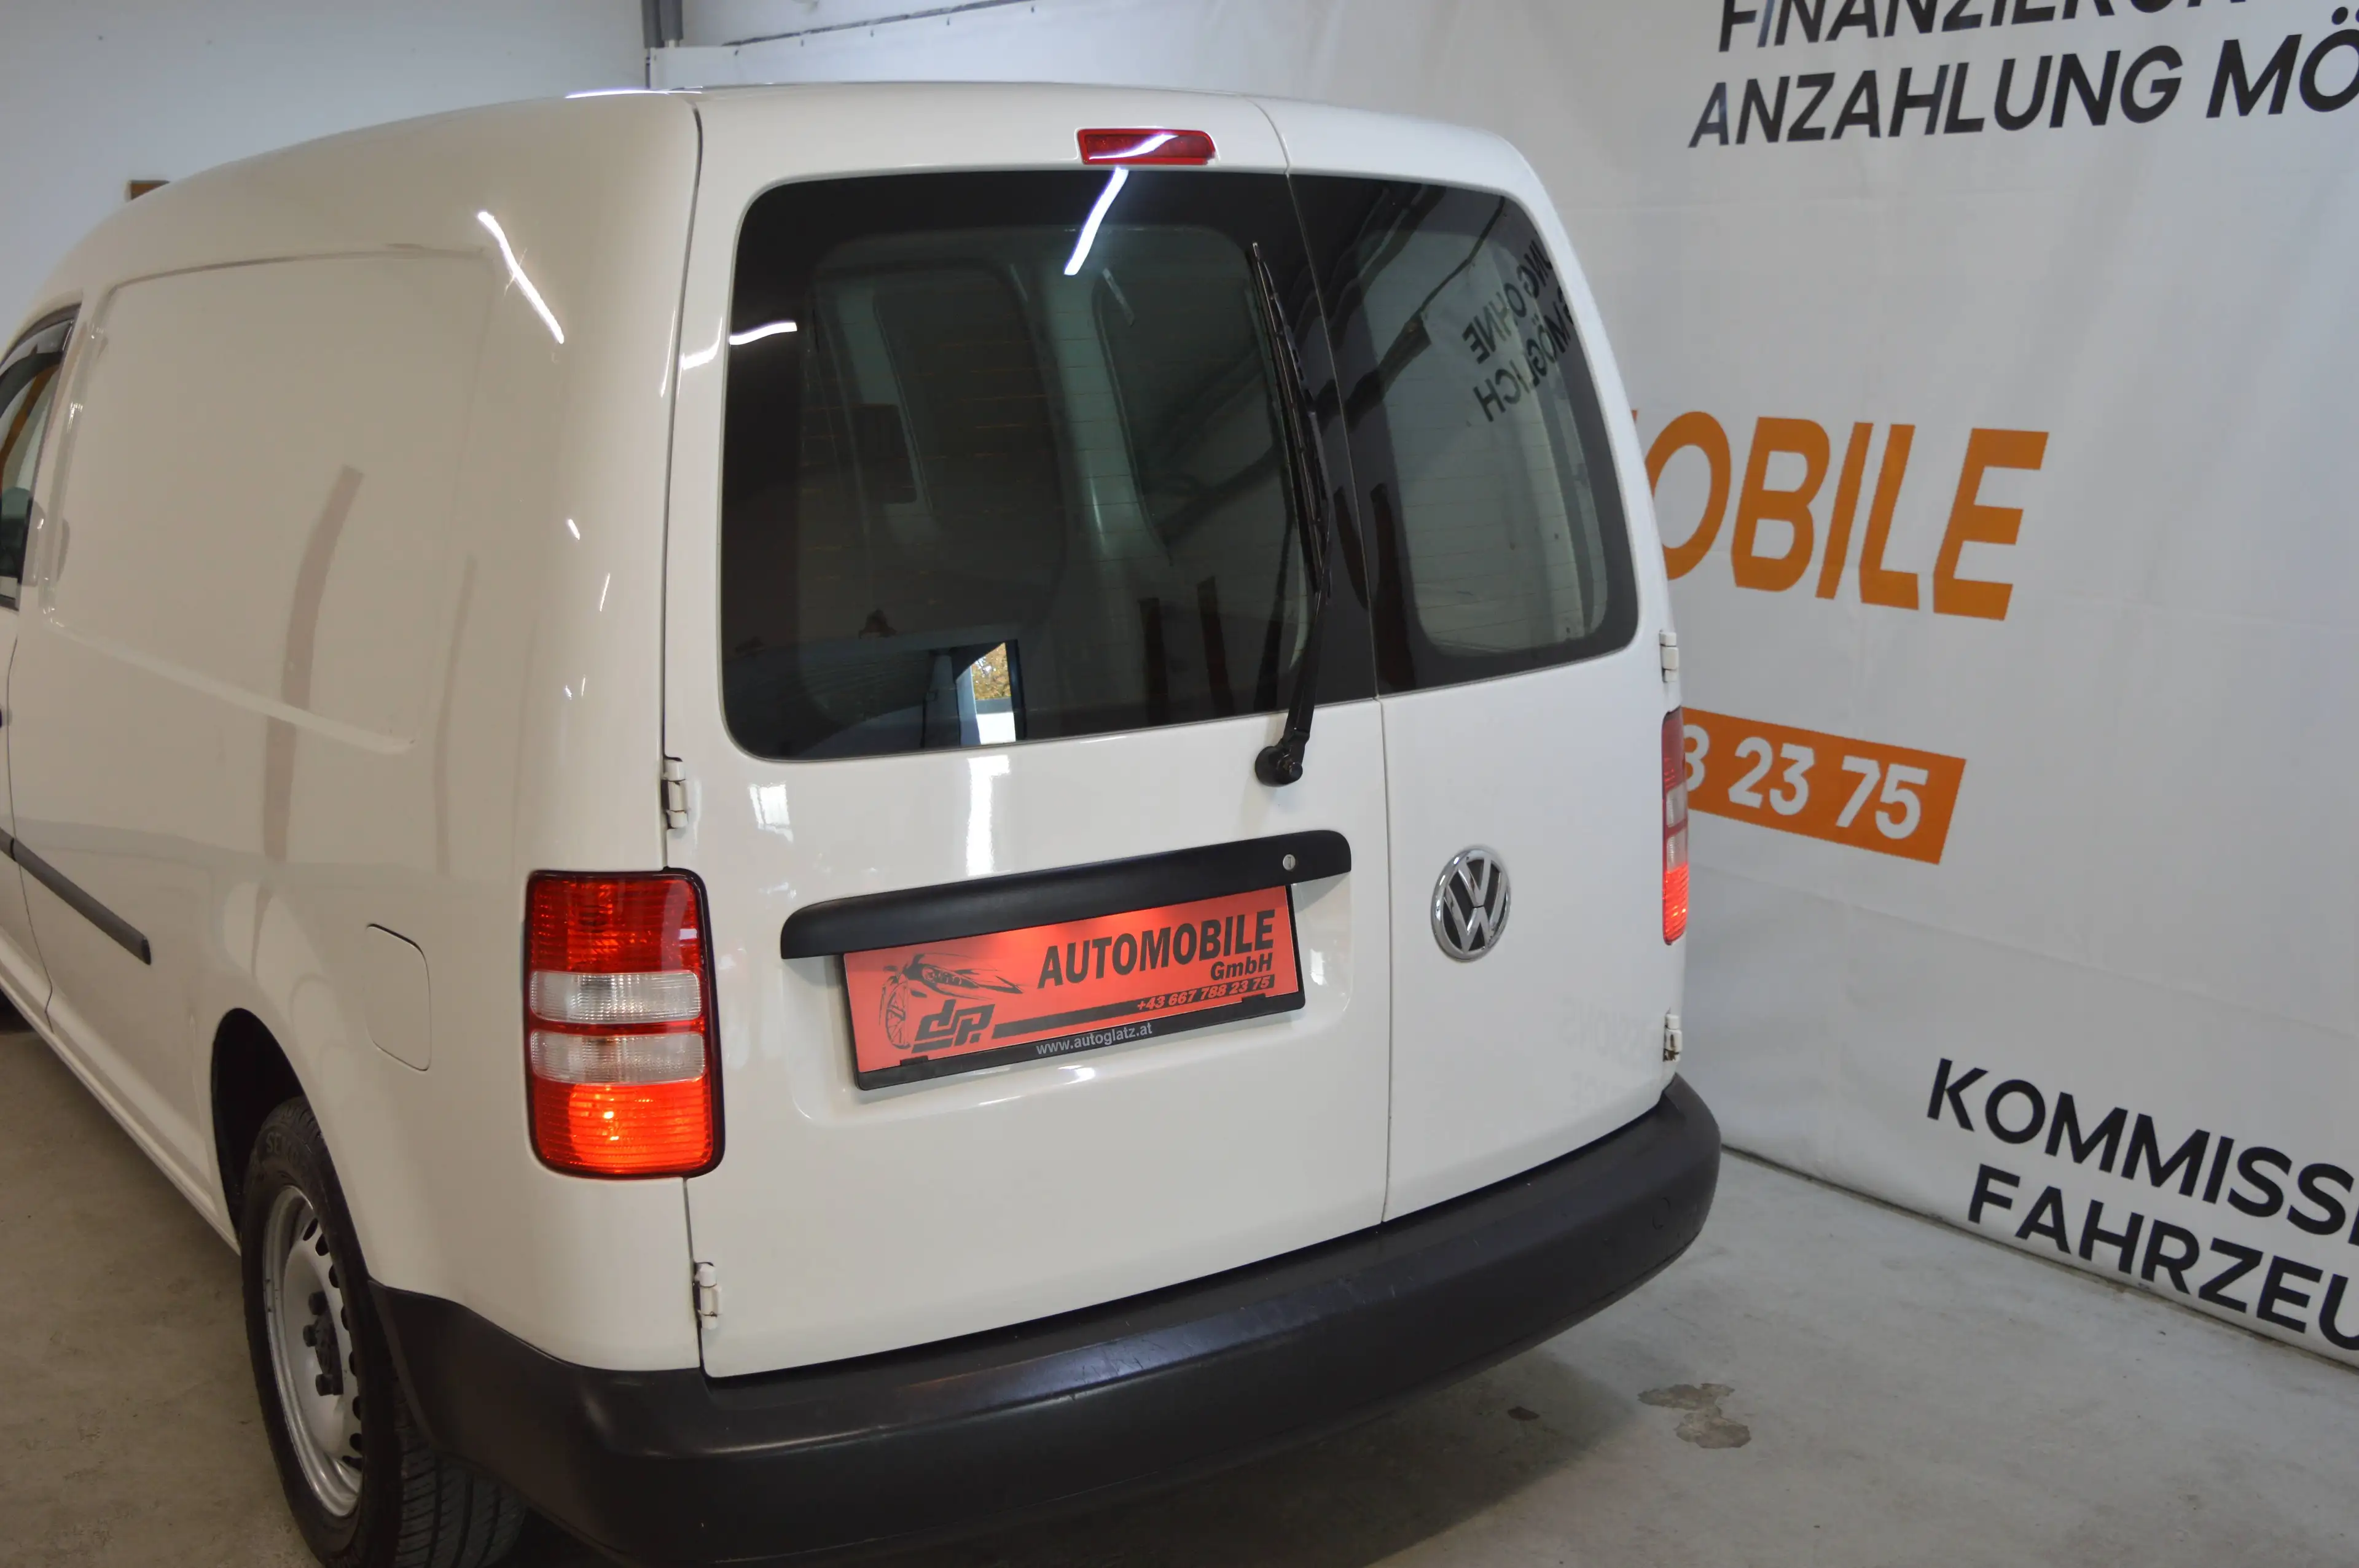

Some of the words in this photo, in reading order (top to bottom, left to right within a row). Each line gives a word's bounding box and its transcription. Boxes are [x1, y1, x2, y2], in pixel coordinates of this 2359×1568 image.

[1688, 45, 2183, 147] ANZAHLUNG
[1632, 409, 2049, 621] OBILE
[1727, 736, 1815, 816] 23
[1835, 755, 1929, 840] 75
[1038, 909, 1275, 989] AUTOMOBILE
[1210, 953, 1273, 981] GmbH
[1137, 996, 1165, 1011] +43
[1168, 989, 1197, 1006] 667
[1200, 985, 1227, 1000] 788
[1229, 980, 1249, 996] 23
[1252, 975, 1270, 989] 75
[1036, 1021, 1153, 1056] www.autoglatz.at
